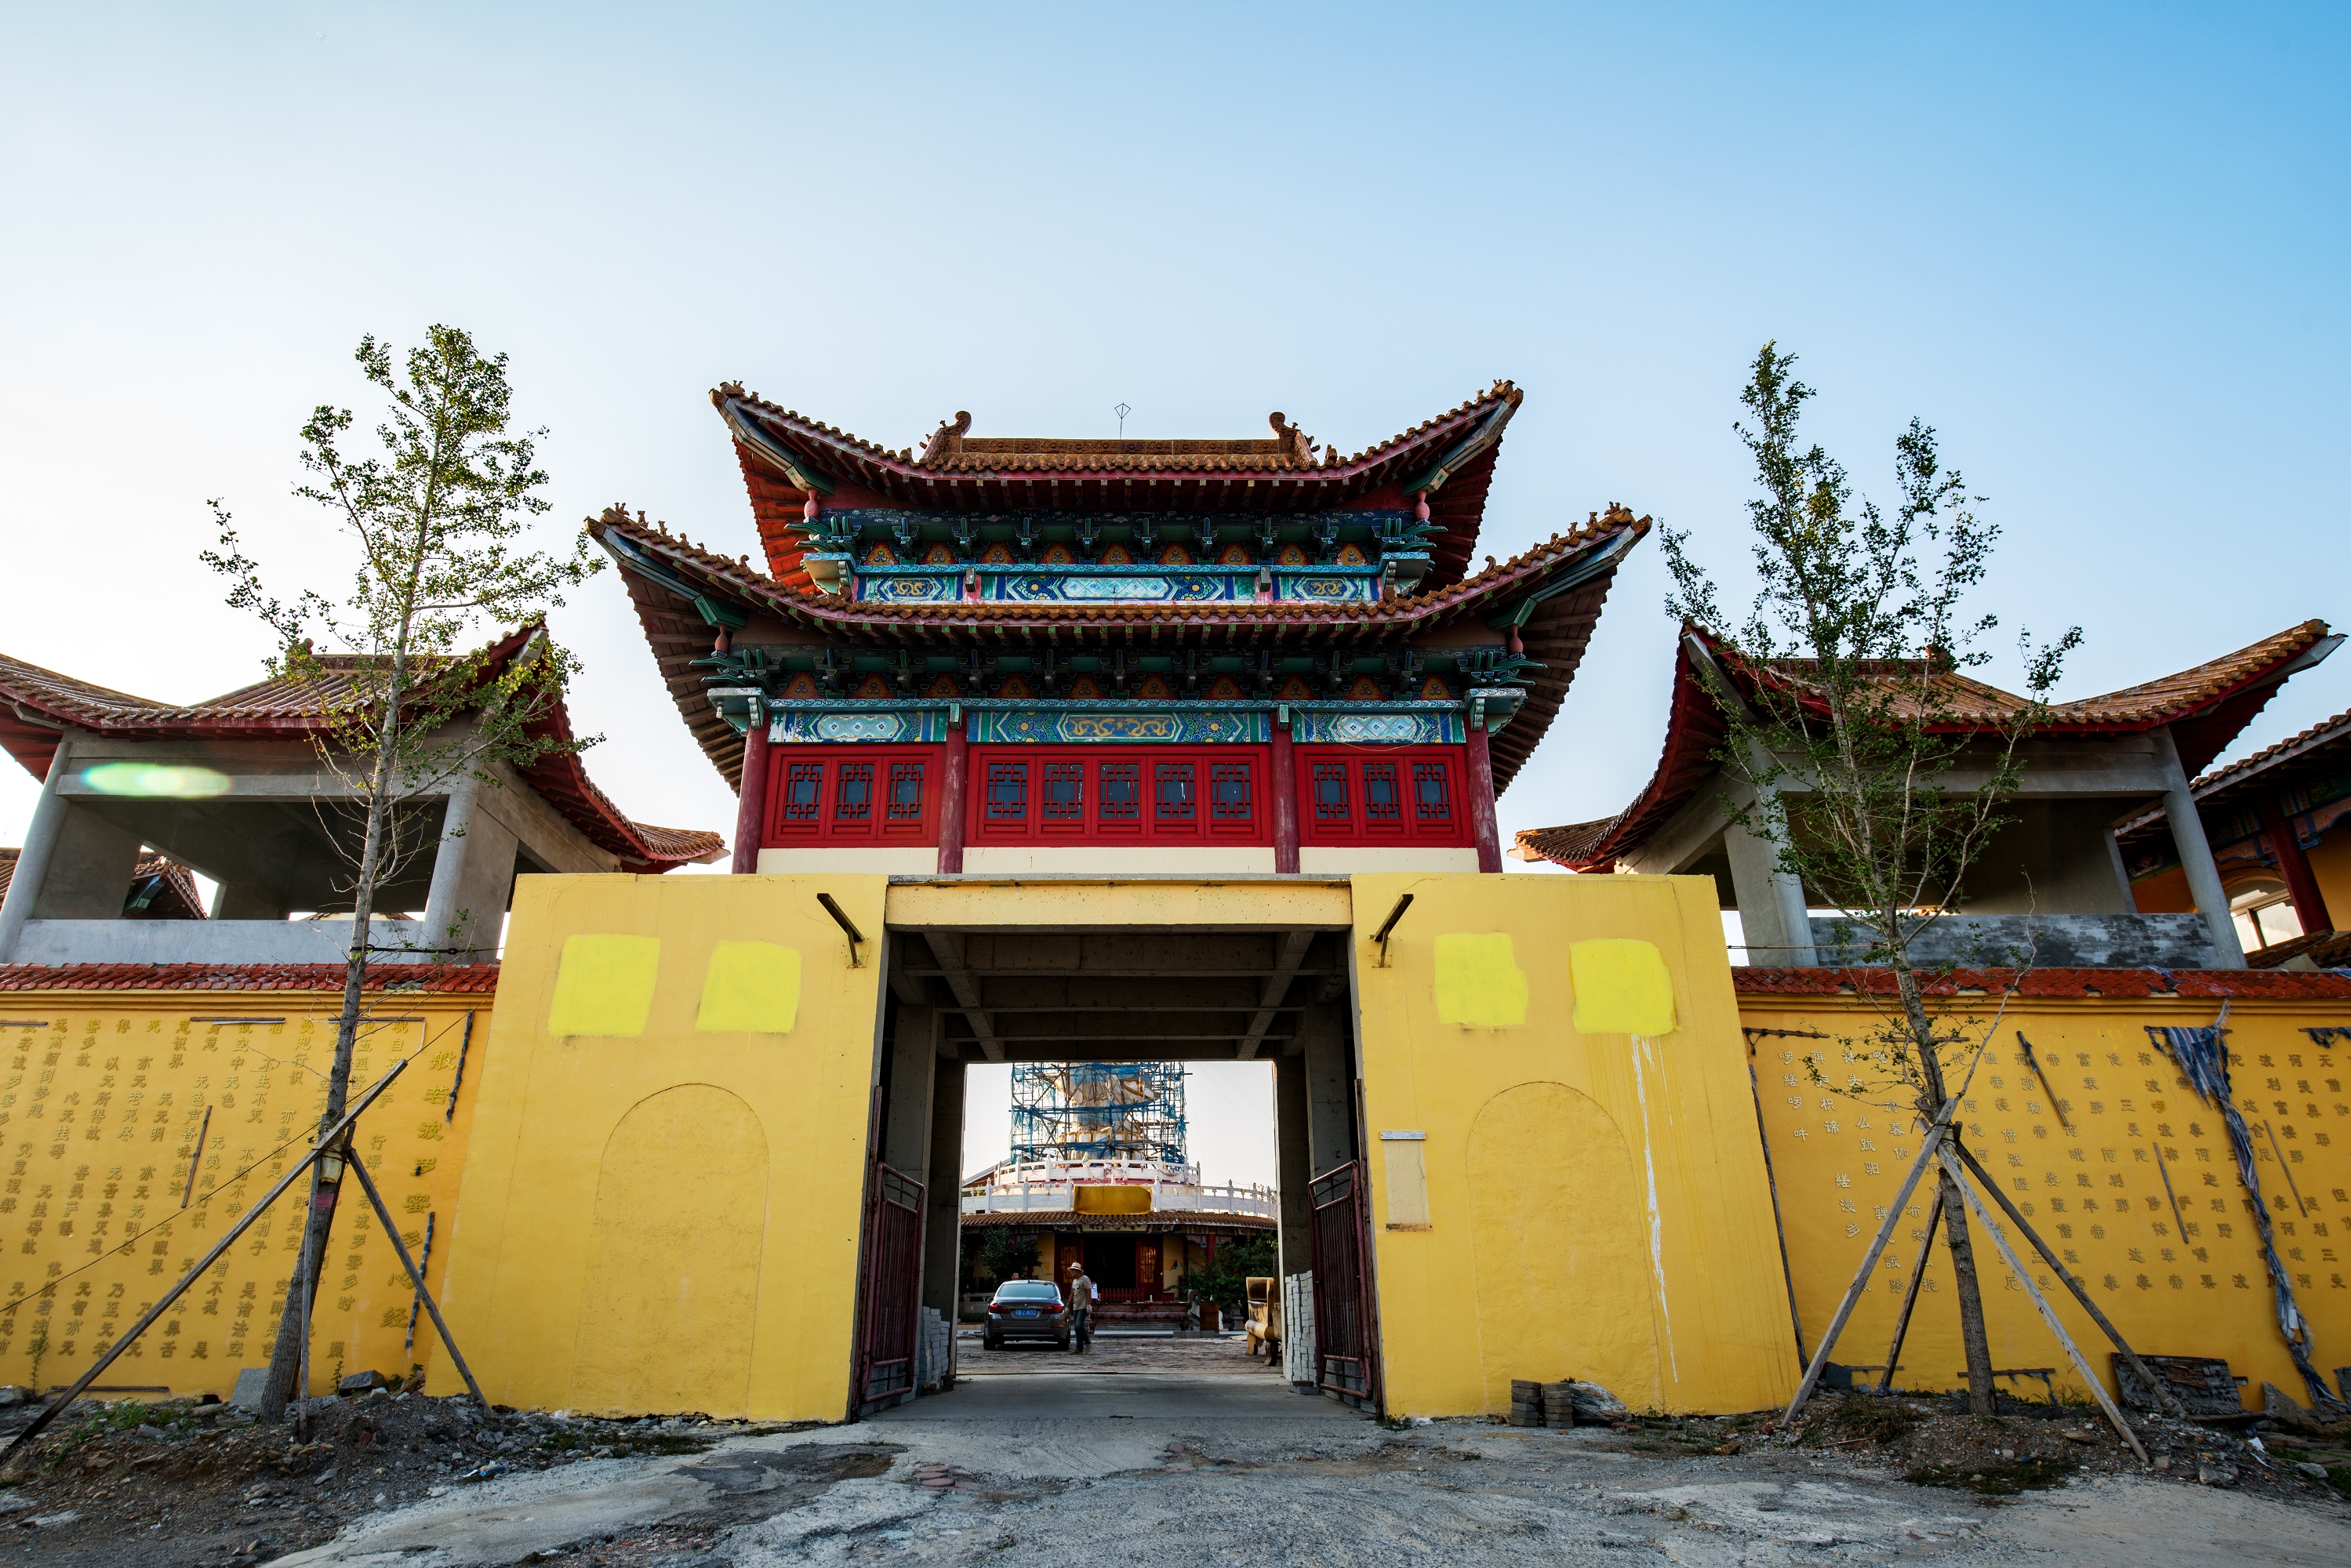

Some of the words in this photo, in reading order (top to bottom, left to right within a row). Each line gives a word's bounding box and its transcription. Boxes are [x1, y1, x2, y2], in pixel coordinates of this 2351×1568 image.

[76, 1018, 100, 1067] 蜜多故
[115, 1019, 131, 1033] 得
[145, 1019, 162, 1033] 死
[168, 1019, 191, 1069] 意识界
[289, 1020, 314, 1085] 受想行识
[2046, 1052, 2060, 1066] 帝
[26, 1018, 68, 1119] 远离颠倒梦想
[85, 1055, 119, 1142] 以无所得故
[118, 1055, 153, 1142] 亦无老死尽
[221, 1022, 253, 1108] 故空中无色
[245, 1058, 274, 1123] 不生不灭
[378, 1022, 409, 1109] 观自在萨
[49, 1091, 79, 1160] 心无挂碍
[149, 1092, 173, 1142] 无无明
[168, 1075, 209, 1196] 无色声香味触法
[266, 1108, 296, 1178] 亦复如是
[85, 1165, 123, 1255] 无苦集灭道
[118, 1165, 156, 1257] 亦无无明尽
[191, 1135, 225, 1229] 无受想行识
[225, 1147, 255, 1218] 不垢不净
[380, 1050, 456, 1328] 般若波罗蜜多心经
[147, 1222, 173, 1276] 无眼界
[337, 1135, 387, 1312] 行深若波罗蜜多时
[57, 1281, 92, 1356] 无智亦无
[92, 1282, 125, 1358] 乃至无老
[125, 1301, 152, 1358] 乃无
[160, 1258, 195, 1359] 无耳鼻舌
[226, 1281, 256, 1358] 是诸法空
[191, 1341, 209, 1359] 是
[327, 1341, 344, 1359] 照
